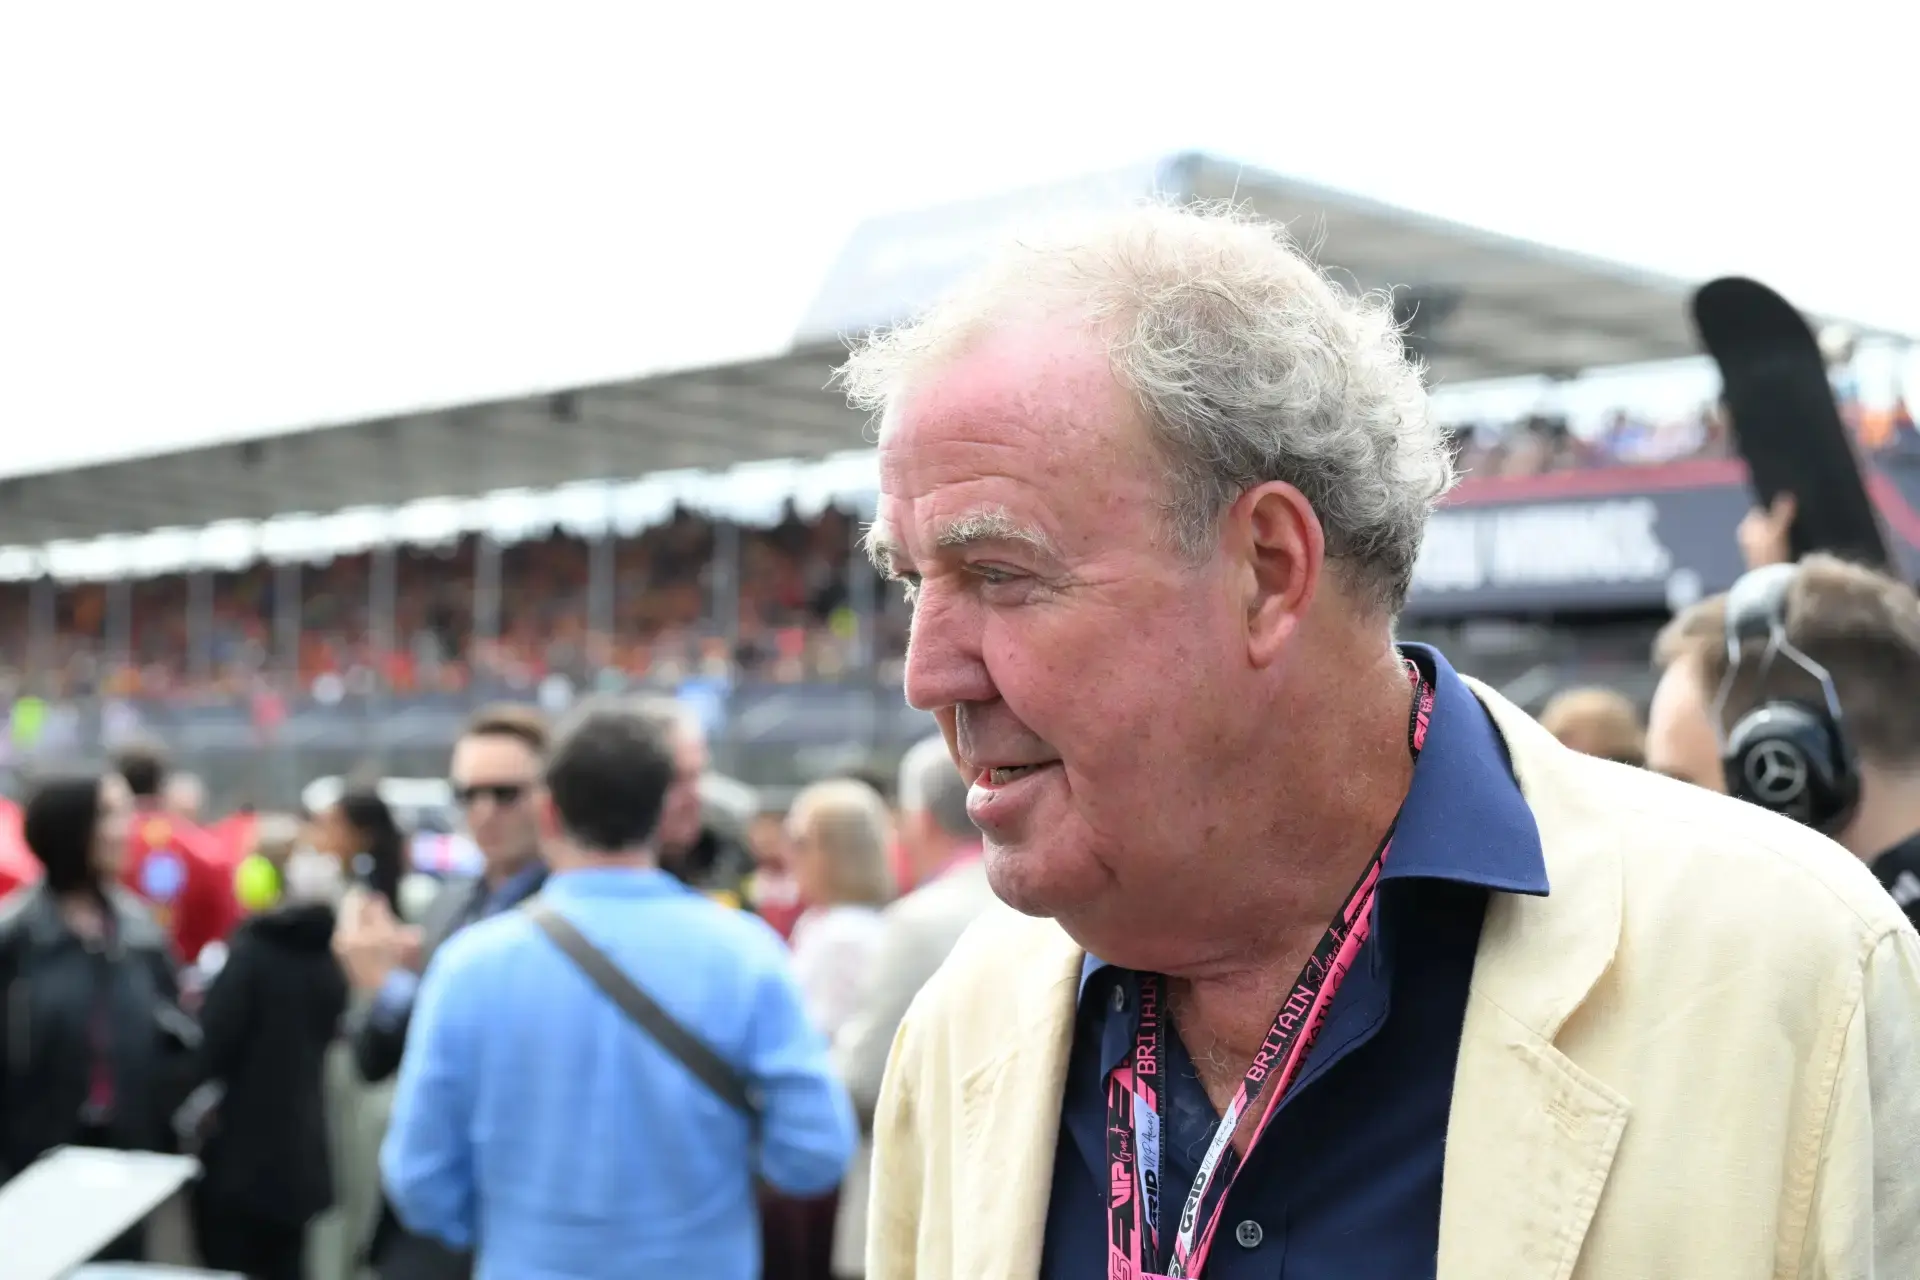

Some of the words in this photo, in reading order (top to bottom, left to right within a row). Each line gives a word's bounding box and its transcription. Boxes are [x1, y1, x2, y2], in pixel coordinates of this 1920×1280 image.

[1245, 985, 1315, 1082] BRITAIN
[1109, 1123, 1133, 1162] Guest
[1141, 1111, 1157, 1142] Access
[1142, 1141, 1157, 1168] VIP
[1111, 1161, 1132, 1209] VIP
[1180, 1171, 1207, 1234] GRID
